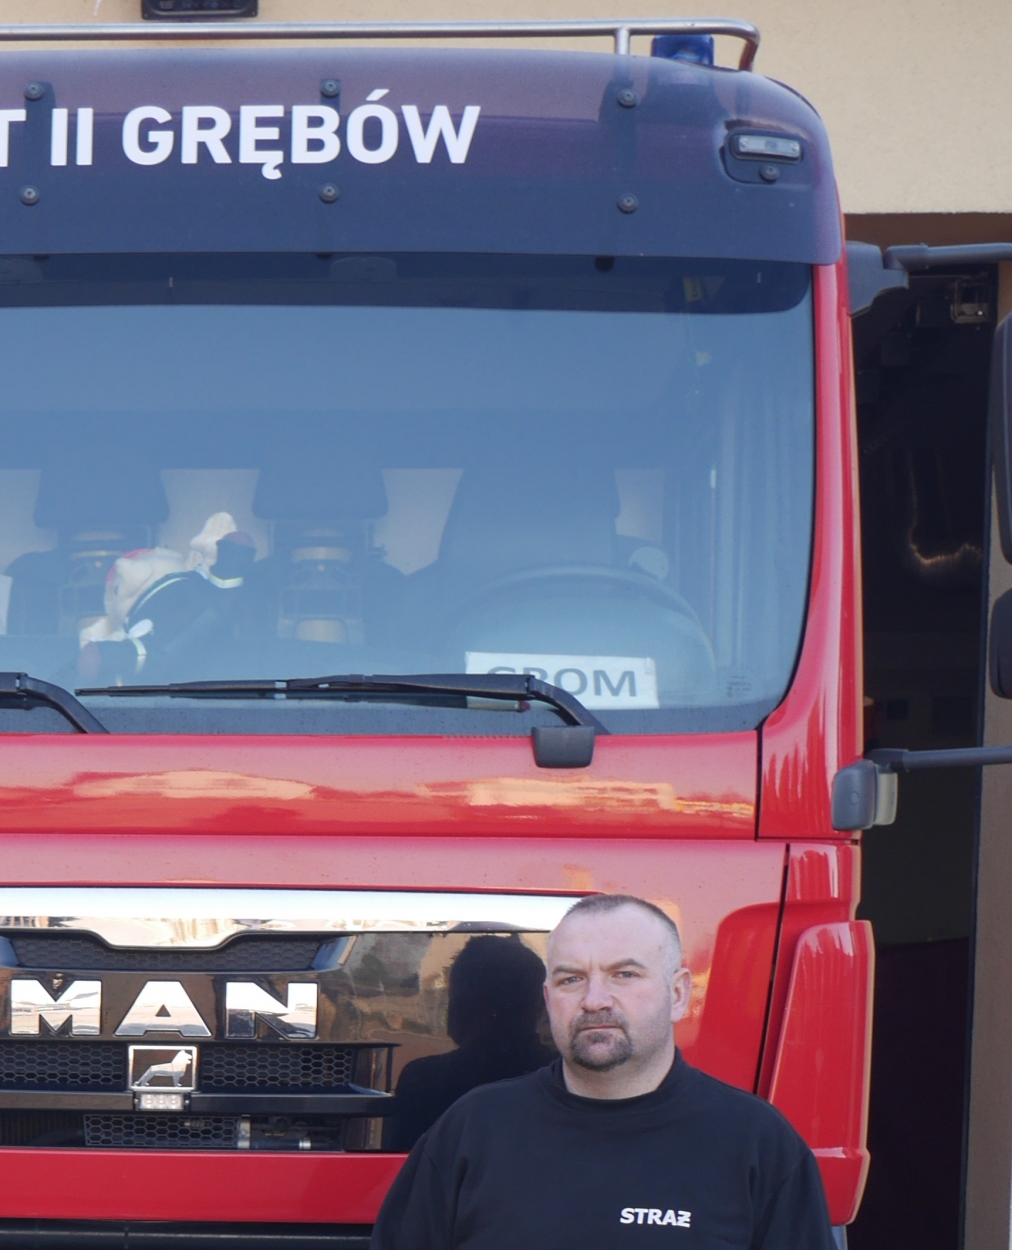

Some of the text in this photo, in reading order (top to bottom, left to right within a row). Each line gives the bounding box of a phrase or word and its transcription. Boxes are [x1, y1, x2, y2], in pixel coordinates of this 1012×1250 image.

[50, 107, 94, 166] II
[122, 89, 481, 180] GRĘBÓW
[10, 978, 319, 1040] MAN
